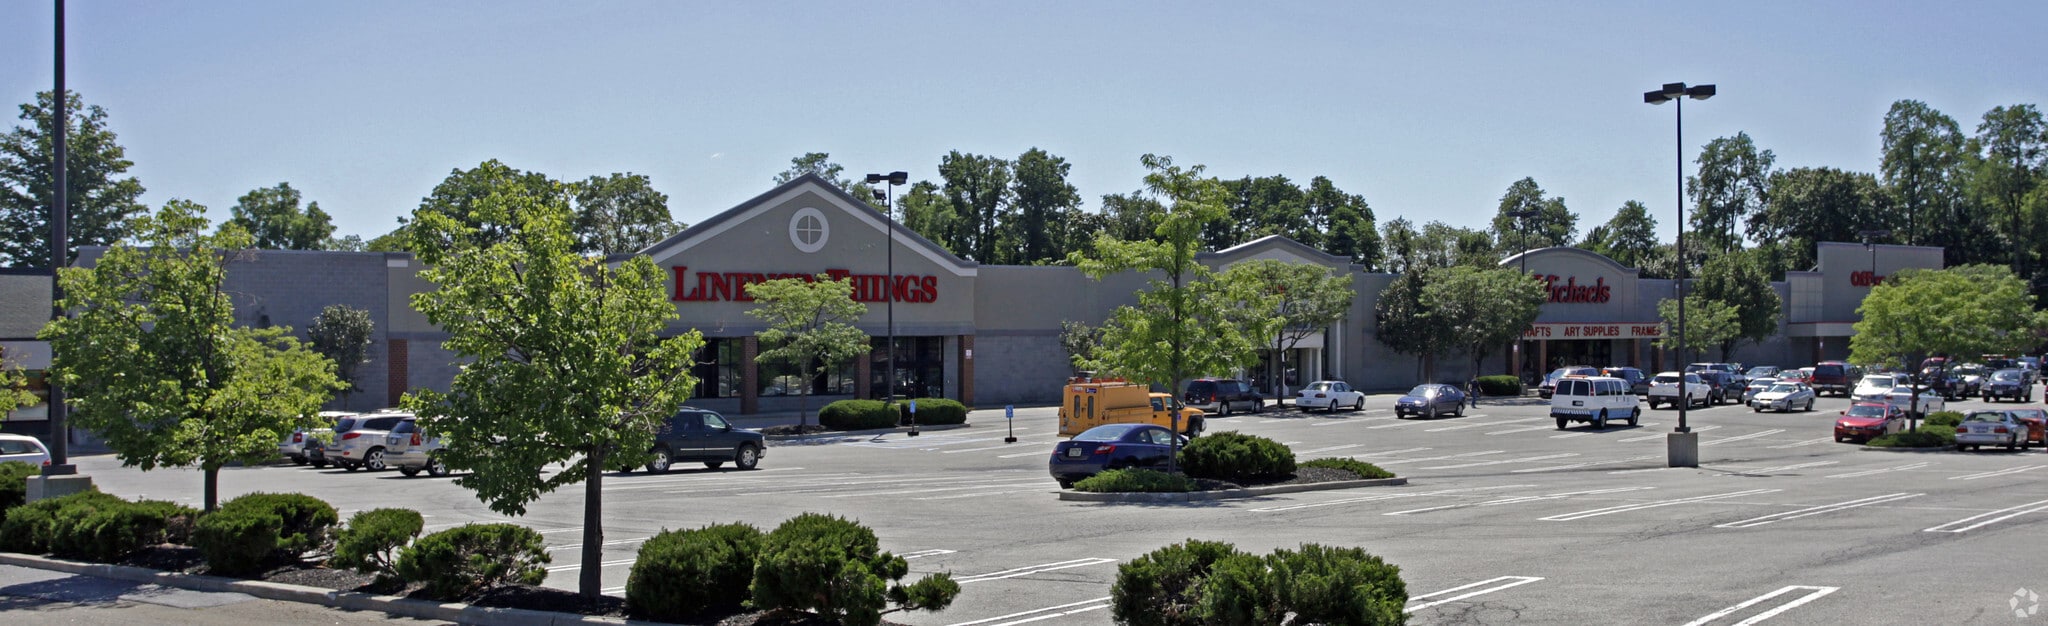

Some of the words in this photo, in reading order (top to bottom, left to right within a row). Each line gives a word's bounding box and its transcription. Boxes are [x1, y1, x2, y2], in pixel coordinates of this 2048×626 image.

[1523, 326, 1552, 338] RAFTS
[1564, 326, 1581, 337] ART
[1583, 326, 1620, 337] SUPPLIES
